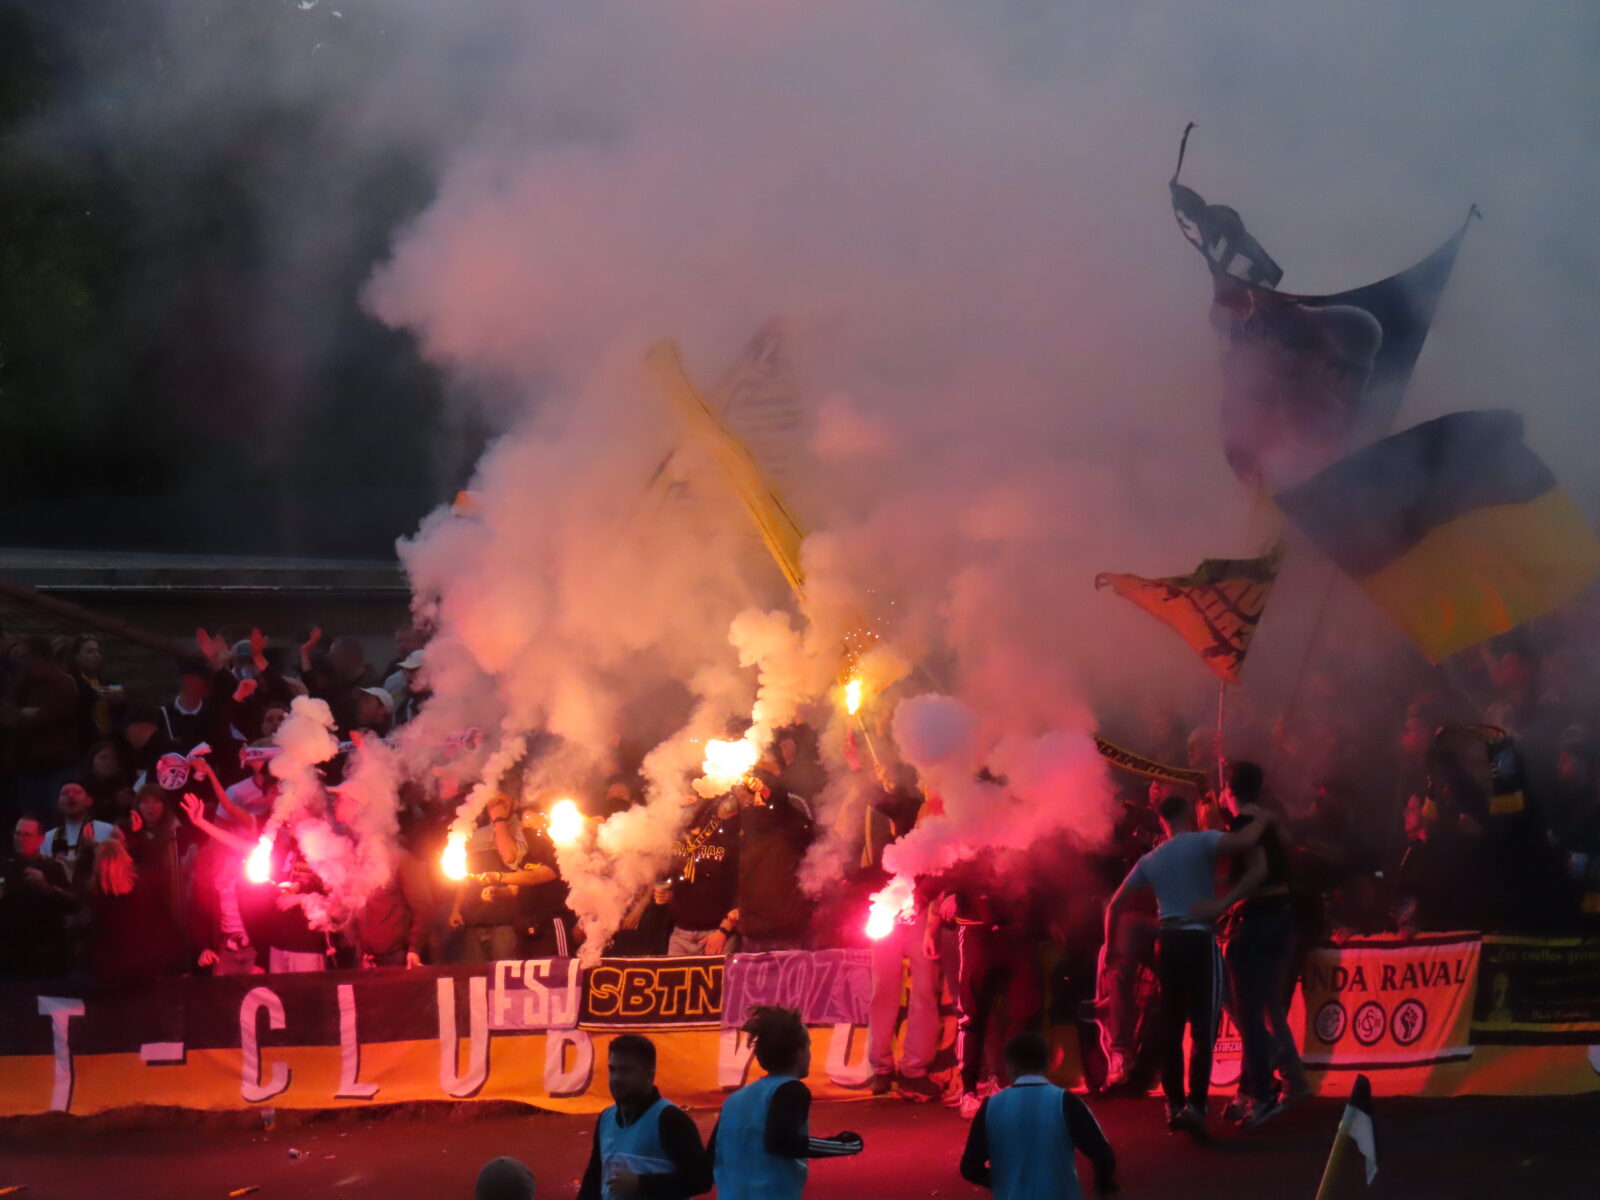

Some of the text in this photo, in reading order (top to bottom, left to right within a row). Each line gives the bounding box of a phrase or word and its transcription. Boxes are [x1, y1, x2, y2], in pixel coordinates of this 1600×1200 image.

[494, 958, 580, 1027] FSJ
[589, 965, 724, 1017] SBTN
[726, 949, 844, 1023] 1907
[1302, 958, 1466, 993] NDA RAVAL
